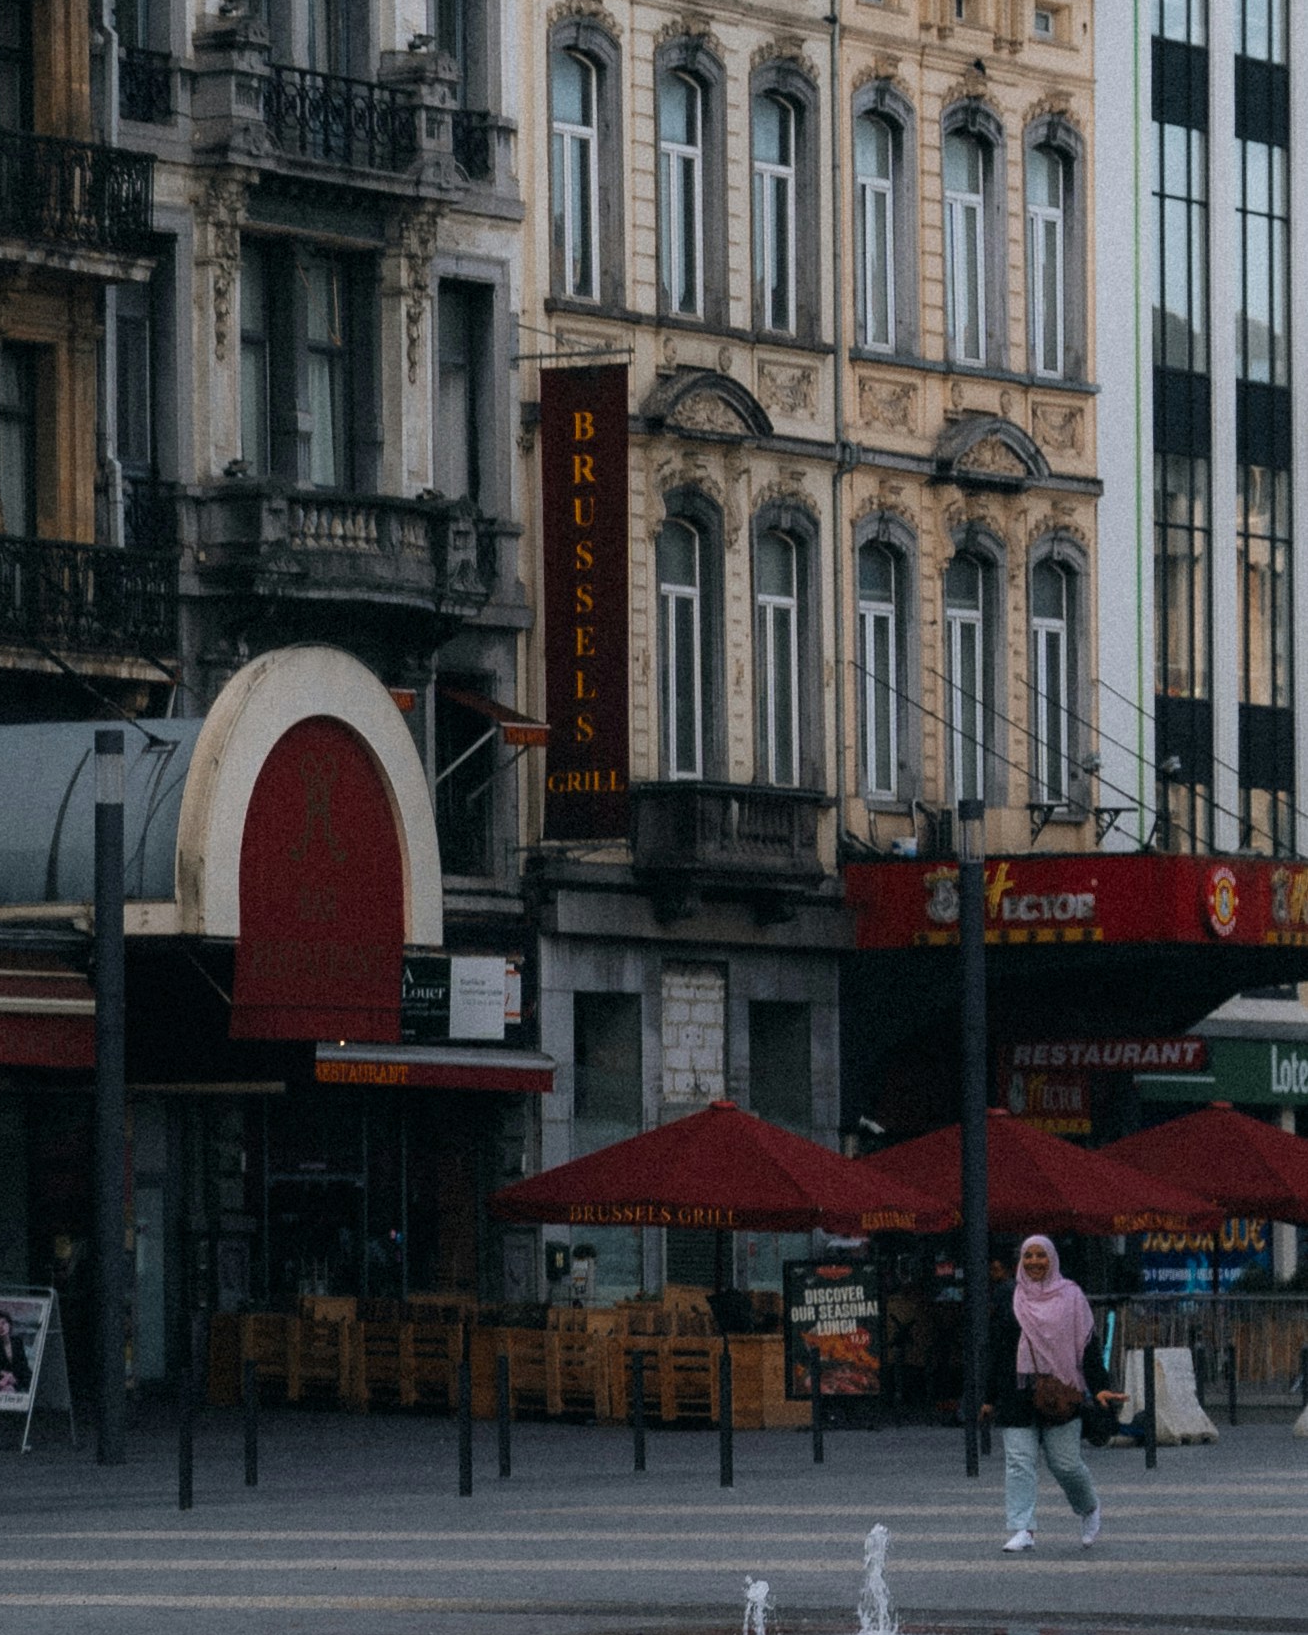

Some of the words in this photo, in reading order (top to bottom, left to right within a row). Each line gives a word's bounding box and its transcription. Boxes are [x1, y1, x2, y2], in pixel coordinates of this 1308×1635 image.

[572, 409, 597, 744] BRUSSELS
[547, 769, 626, 795] GRILL
[401, 983, 446, 1001] Louer
[1013, 1041, 1202, 1067] RESTAURANT
[568, 1203, 672, 1223] BRUSSELS
[677, 1206, 738, 1226] GRILL
[804, 1285, 865, 1305] DISCOVER
[791, 1306, 816, 1323] OUR
[816, 1317, 857, 1337] LUNCH
